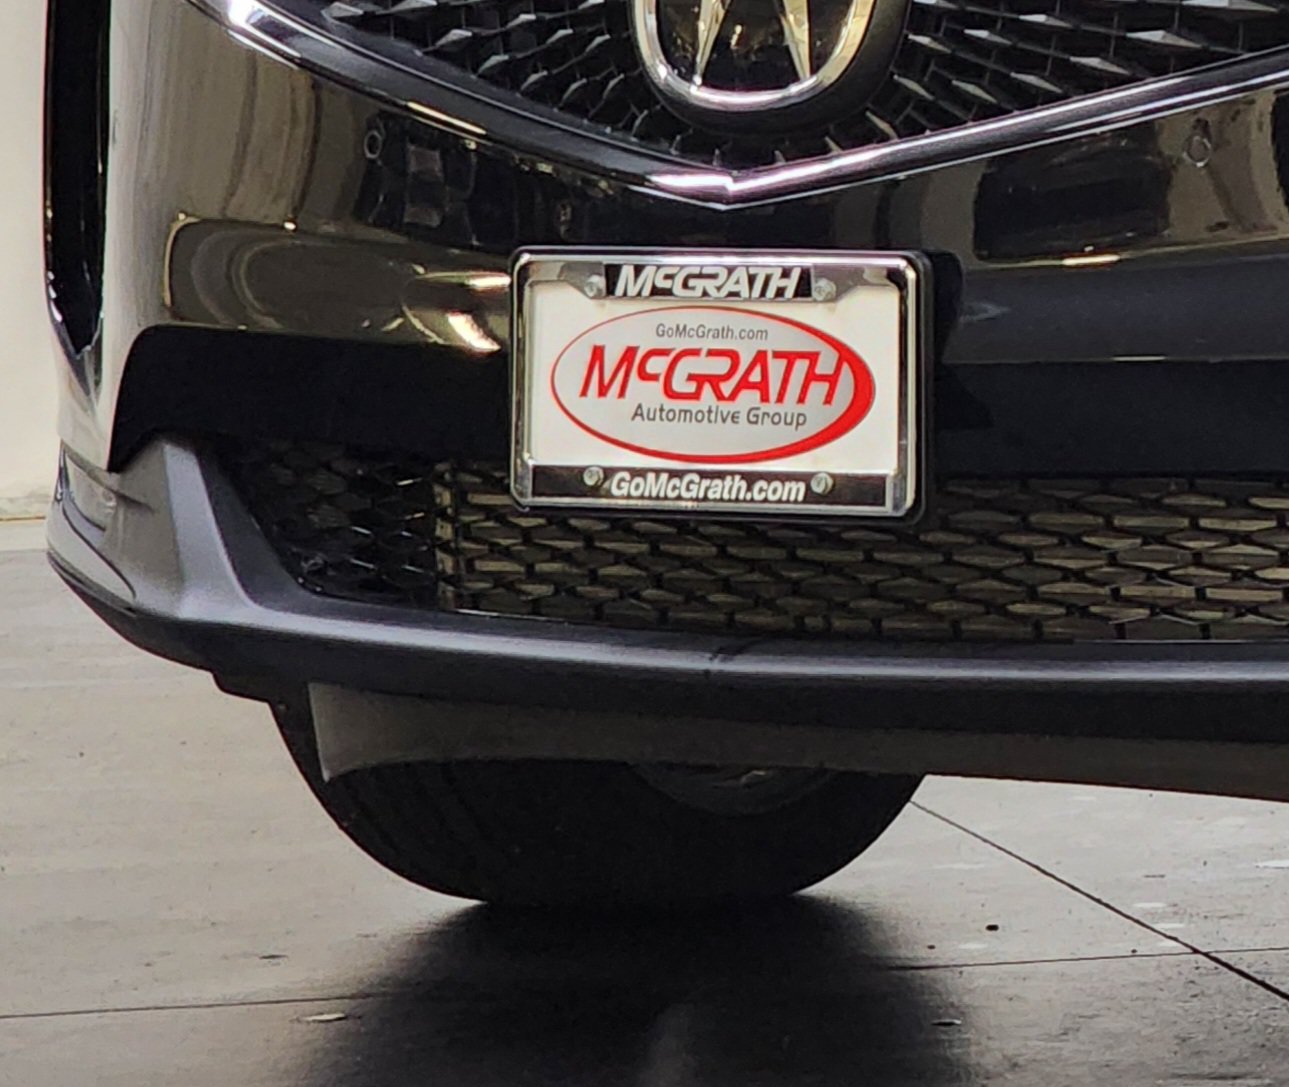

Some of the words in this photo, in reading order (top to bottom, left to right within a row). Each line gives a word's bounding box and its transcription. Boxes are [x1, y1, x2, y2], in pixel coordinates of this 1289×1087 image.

[655, 323, 769, 340] GoMcGrath.com
[631, 402, 740, 425] Automotive
[746, 407, 807, 431] Group
[610, 471, 807, 502] GoMcGrath.com
